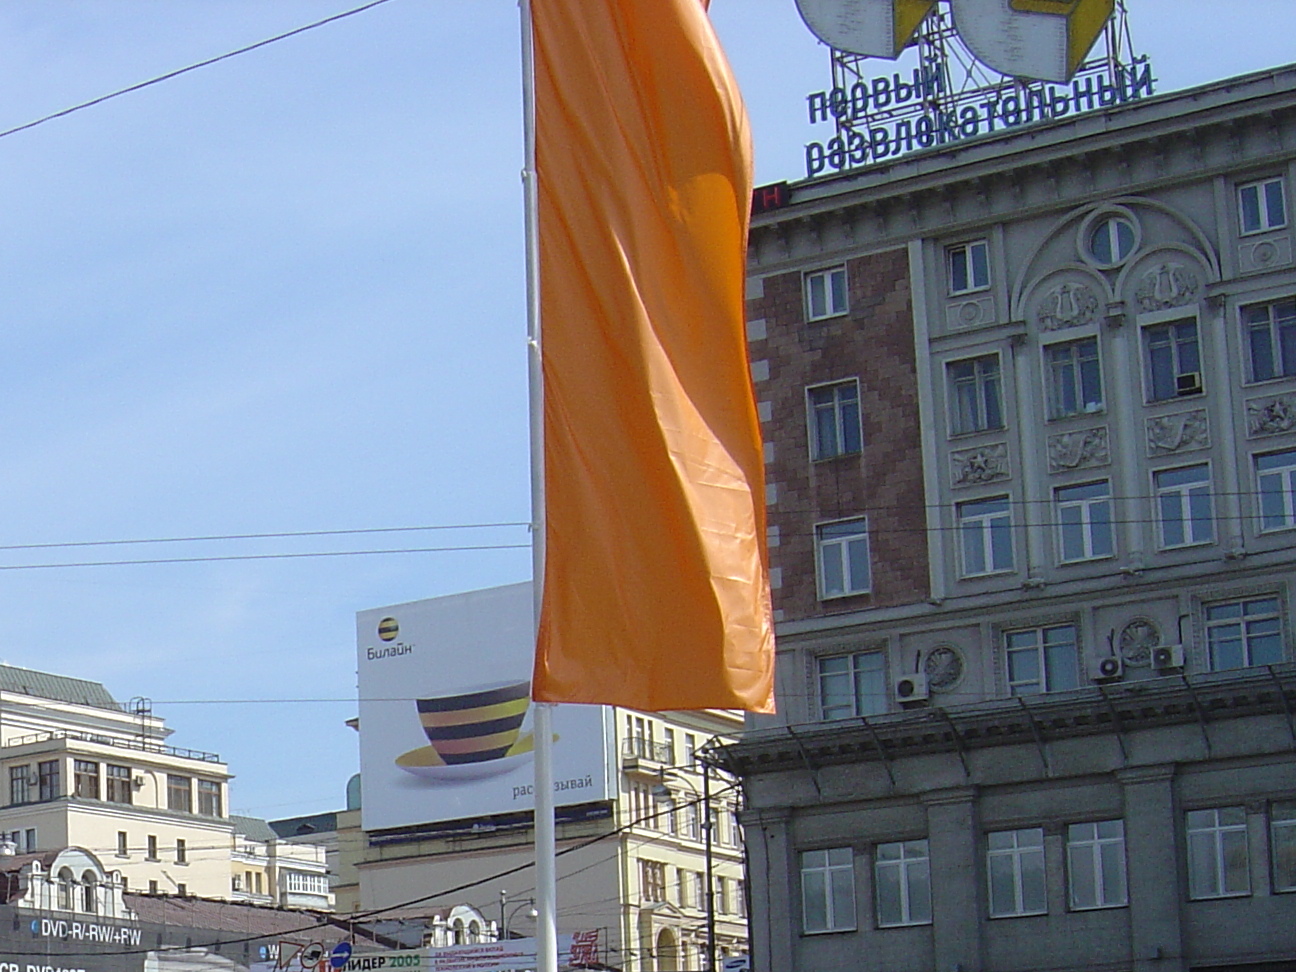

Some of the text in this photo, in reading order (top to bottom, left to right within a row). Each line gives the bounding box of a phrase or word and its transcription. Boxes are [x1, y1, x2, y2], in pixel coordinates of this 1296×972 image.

[367, 642, 413, 660] Билайн
[512, 775, 593, 799] расзывай
[41, 918, 142, 946] DVD-R/-RW/+RW
[389, 954, 422, 968] 2005
